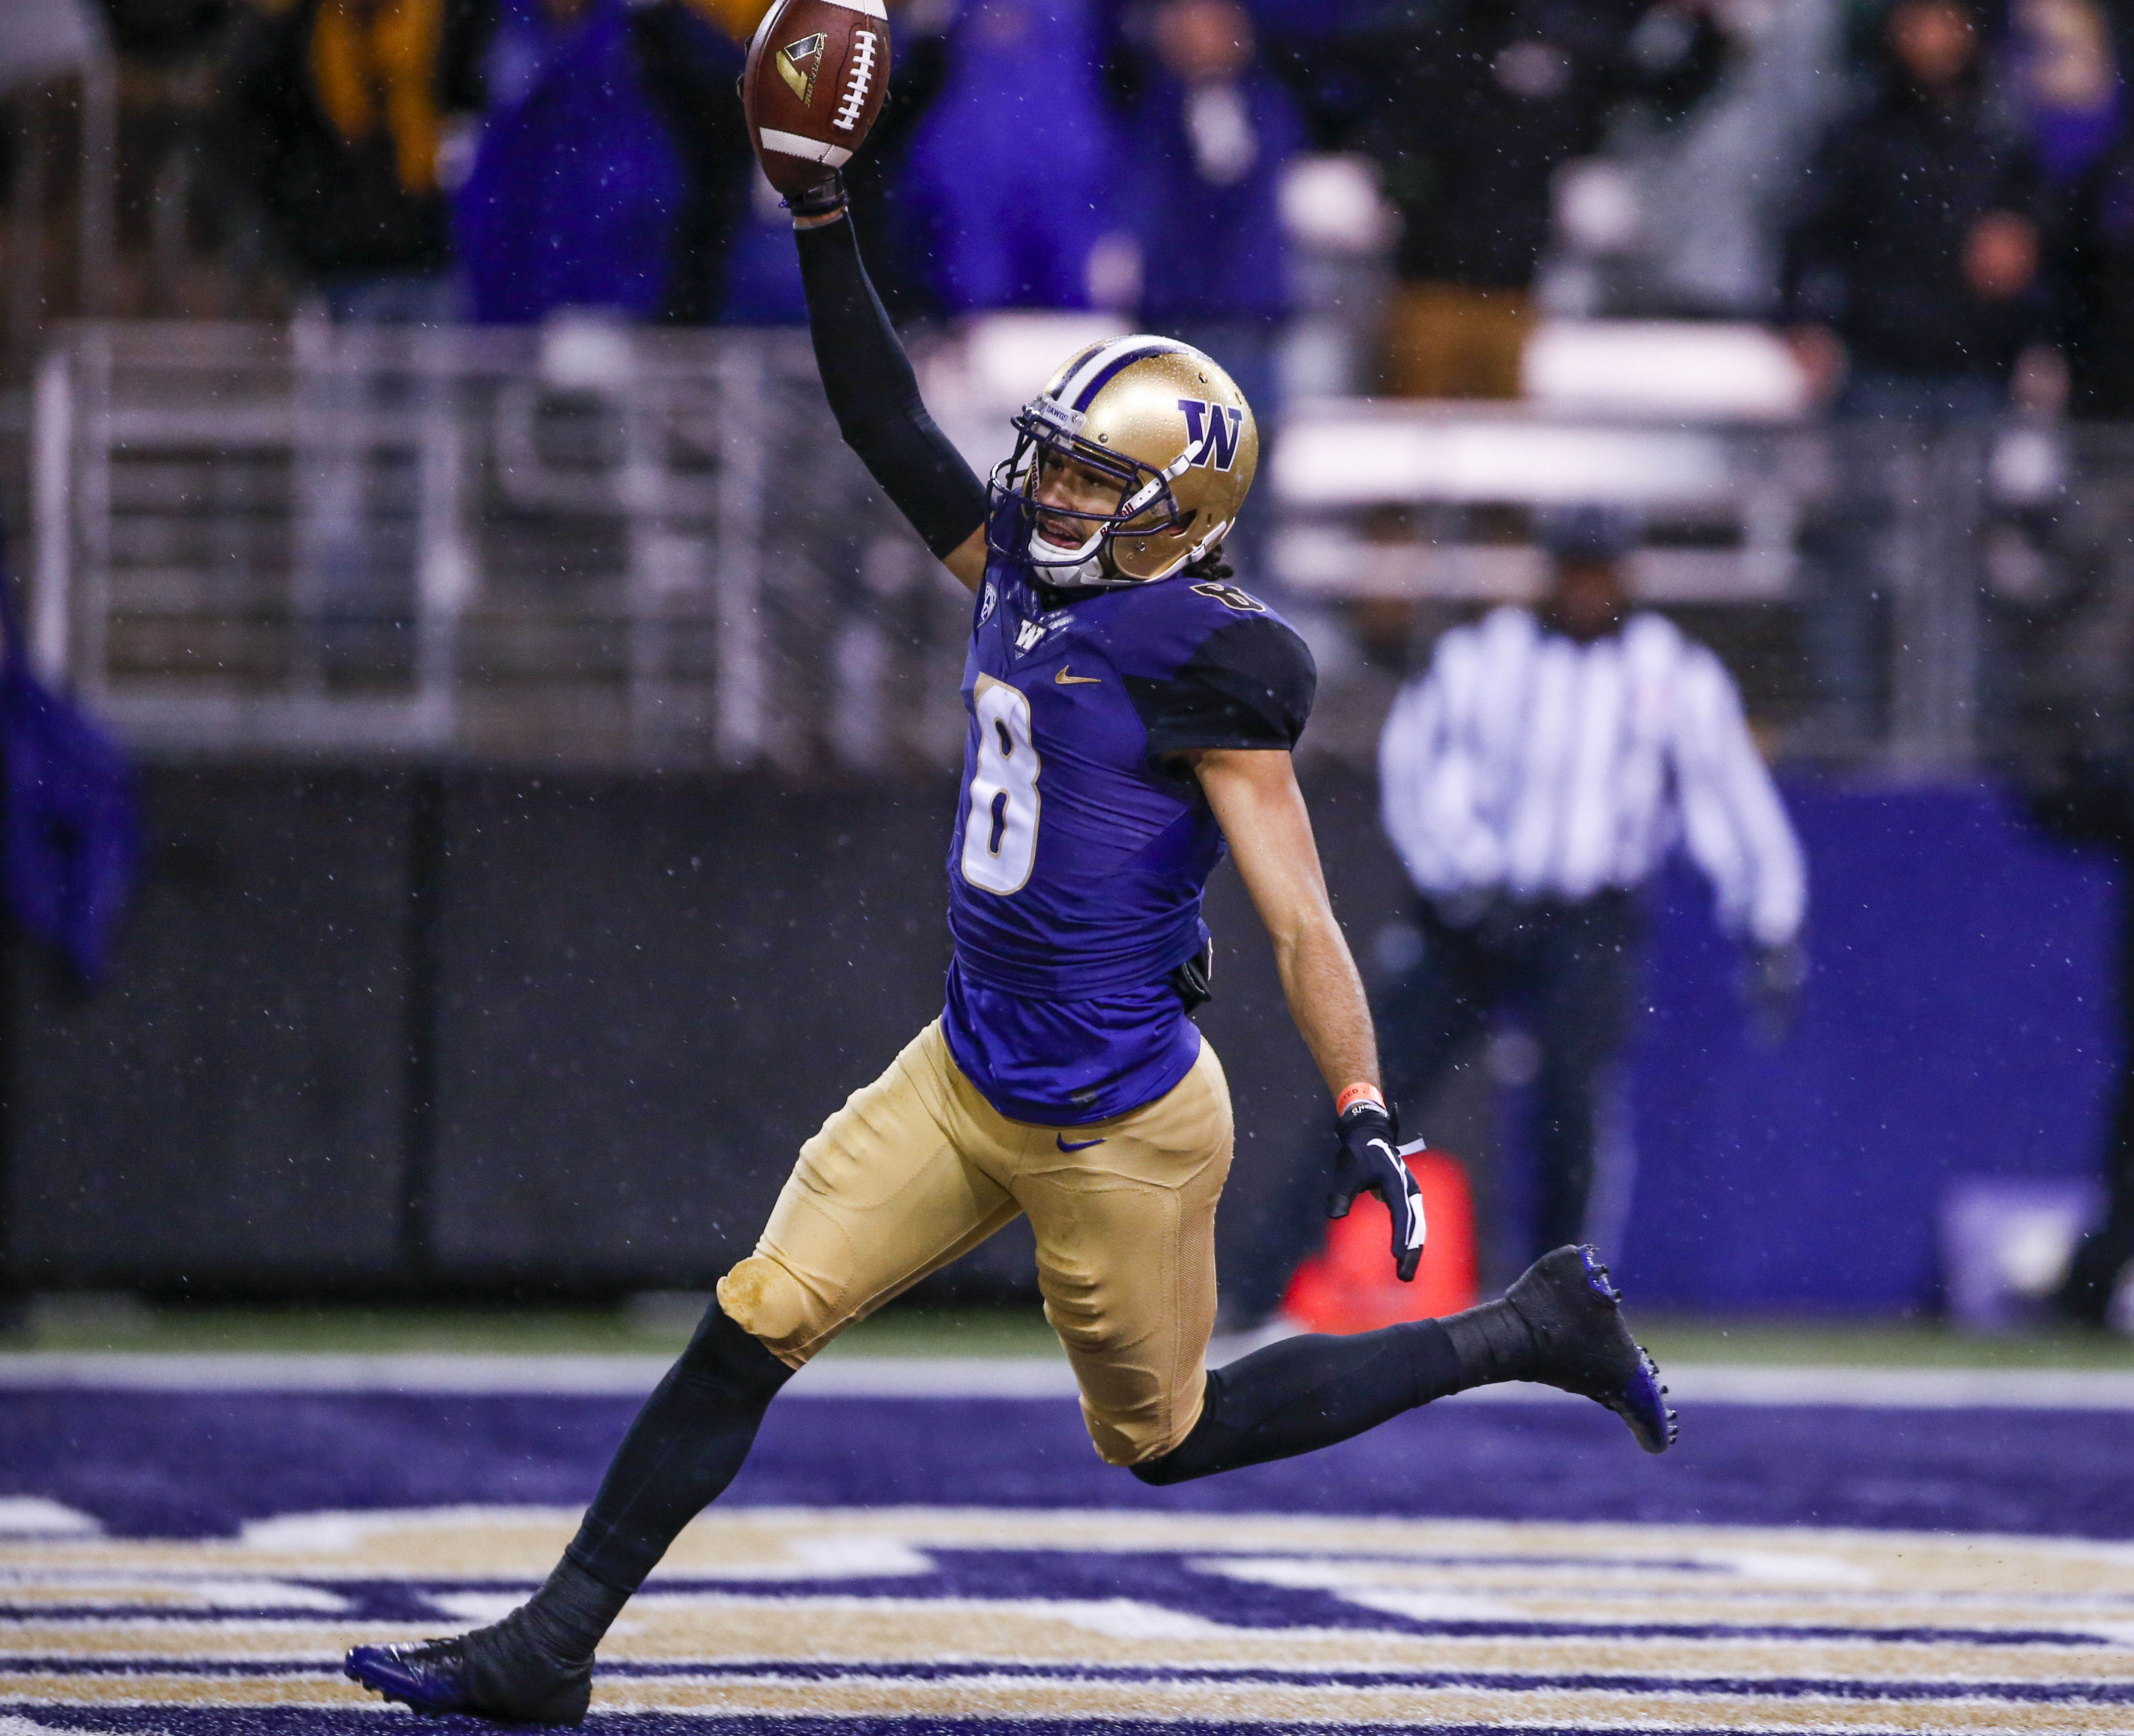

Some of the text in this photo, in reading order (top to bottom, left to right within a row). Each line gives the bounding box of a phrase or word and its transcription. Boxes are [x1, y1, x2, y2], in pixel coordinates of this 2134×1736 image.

[1046, 405, 1068, 422] DAWGS
[1178, 397, 1243, 473] W
[1100, 502, 1135, 537] Rell
[1015, 619, 1046, 652] W
[961, 672, 1041, 896] 8
